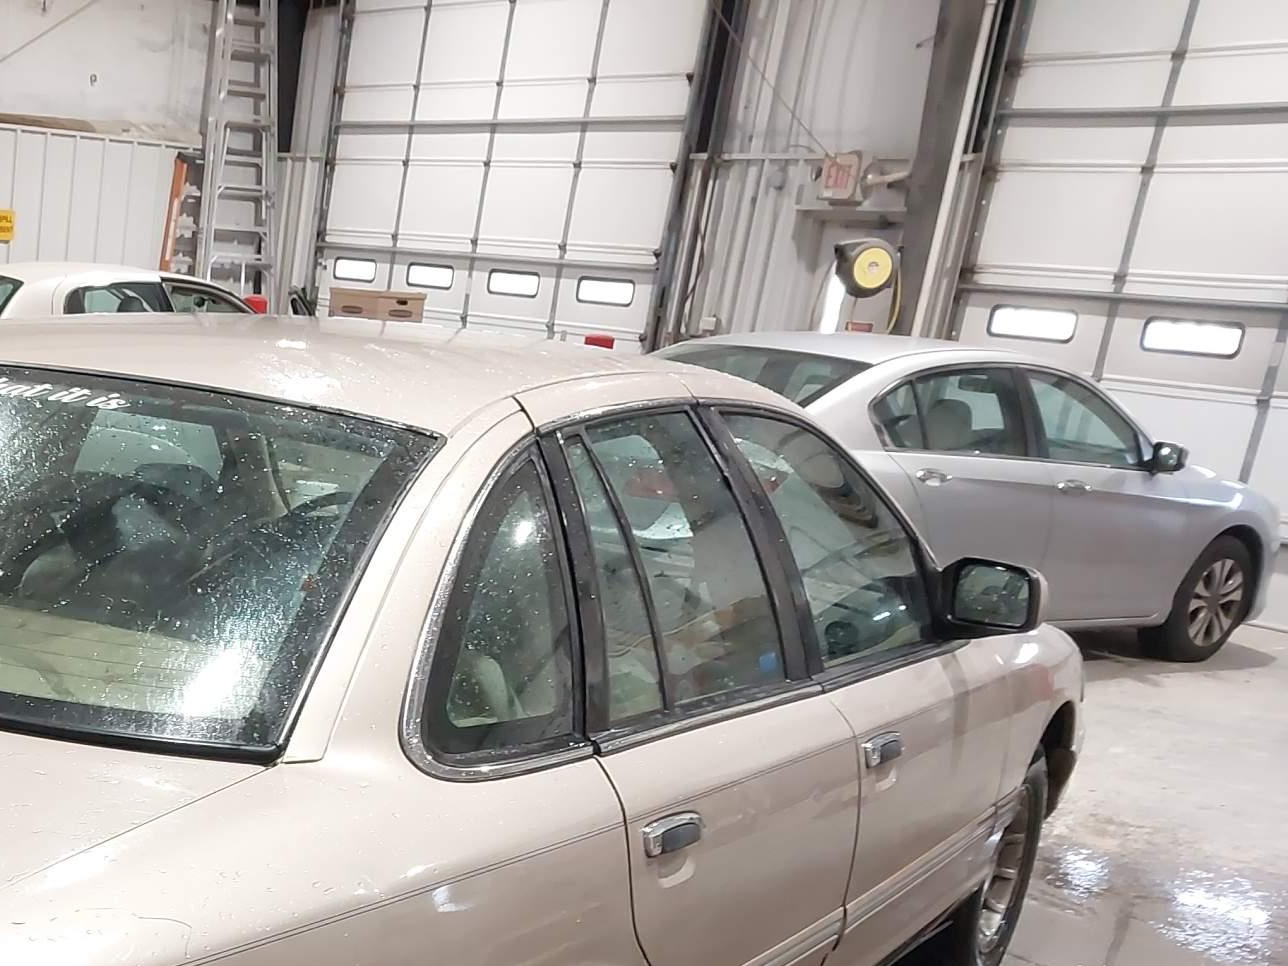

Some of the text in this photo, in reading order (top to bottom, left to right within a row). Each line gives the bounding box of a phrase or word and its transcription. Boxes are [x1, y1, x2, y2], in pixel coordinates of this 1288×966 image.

[825, 159, 853, 190] EXIT
[47, 387, 91, 403] it
[86, 393, 132, 409] is
